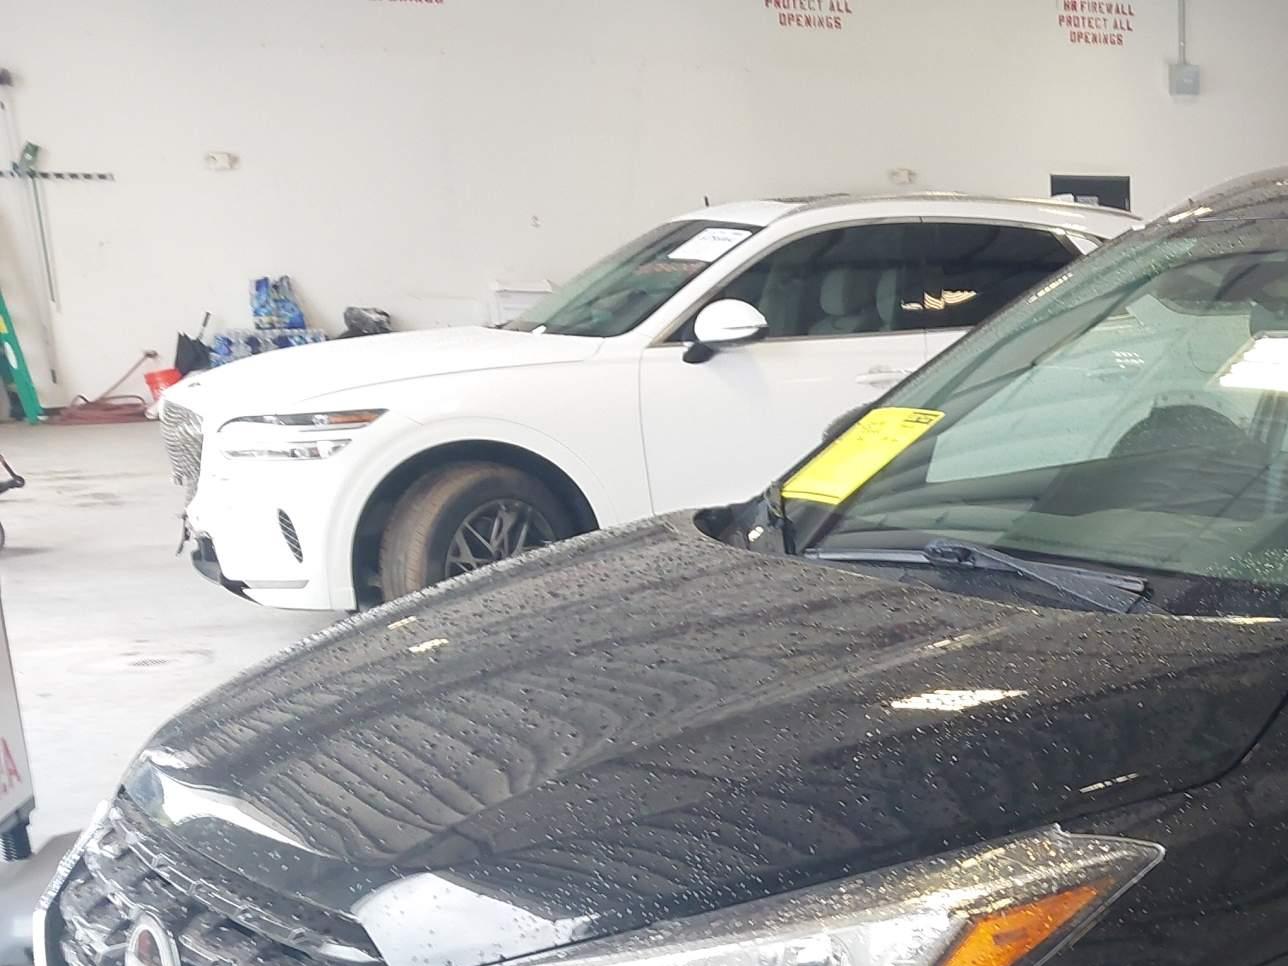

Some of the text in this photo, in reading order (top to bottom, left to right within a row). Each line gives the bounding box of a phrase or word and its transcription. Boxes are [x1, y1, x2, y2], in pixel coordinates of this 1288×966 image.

[829, 0, 853, 14] ALL
[1080, 0, 1135, 17] FIREWALL
[778, 12, 843, 30] OPENINGS
[1058, 14, 1134, 32] PROTECT ALL
[1069, 30, 1124, 46] OPENINGS
